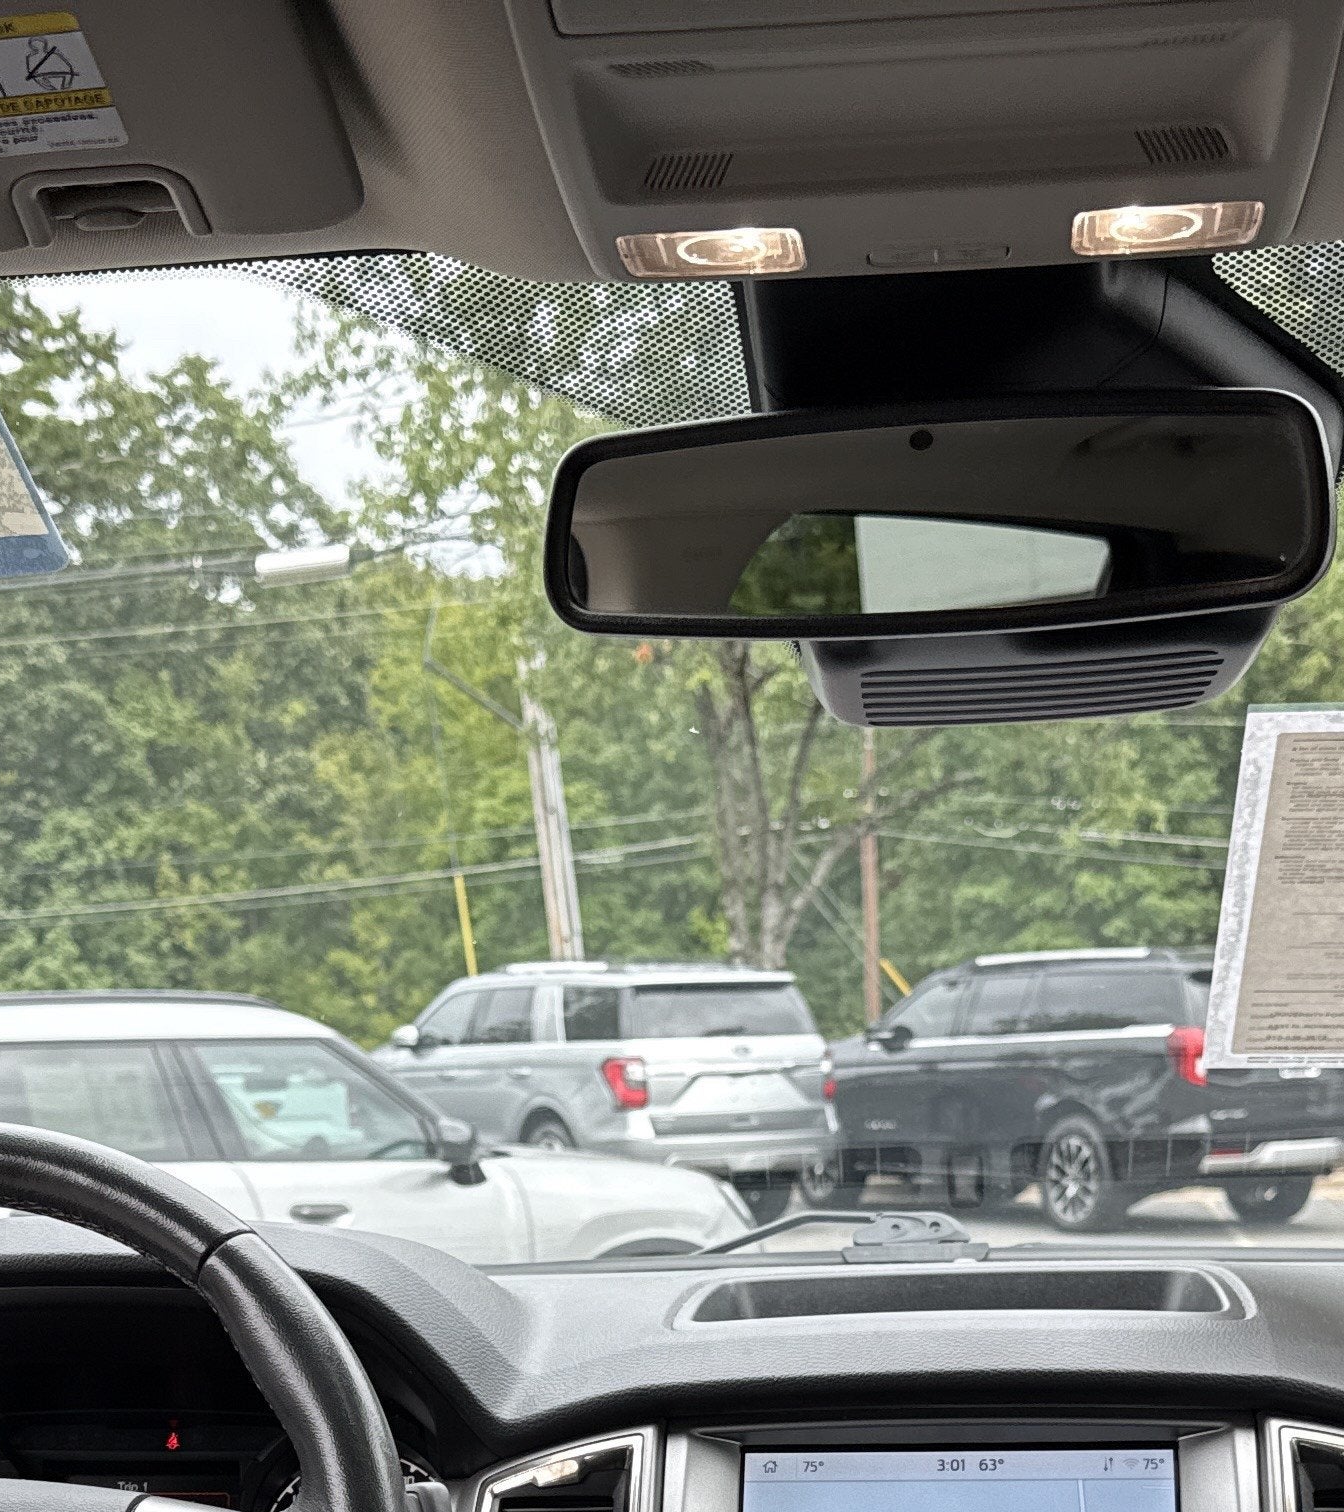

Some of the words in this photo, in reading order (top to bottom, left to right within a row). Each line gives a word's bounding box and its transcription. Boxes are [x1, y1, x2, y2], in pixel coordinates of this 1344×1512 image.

[803, 1460, 825, 1474] 75°
[937, 1459, 966, 1472] 3:01
[978, 1458, 1005, 1472] 63°
[1143, 1458, 1166, 1471] 75°
